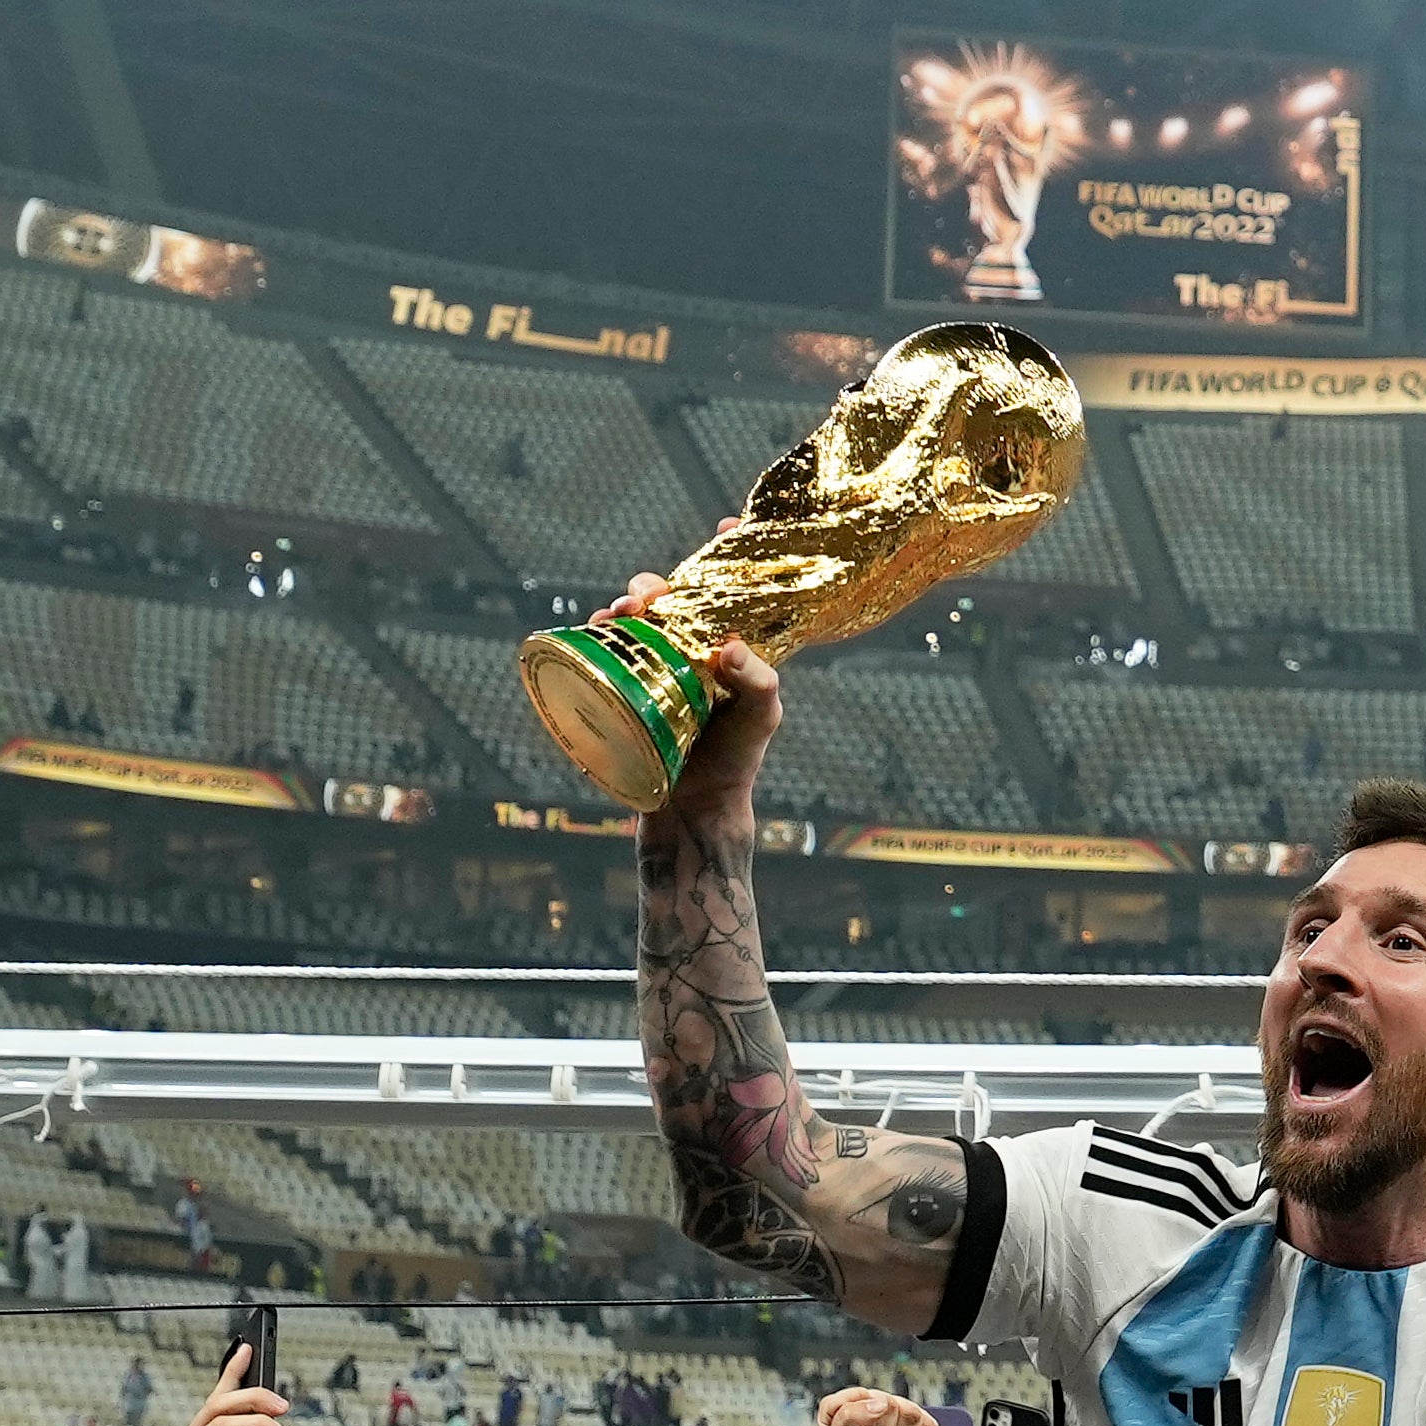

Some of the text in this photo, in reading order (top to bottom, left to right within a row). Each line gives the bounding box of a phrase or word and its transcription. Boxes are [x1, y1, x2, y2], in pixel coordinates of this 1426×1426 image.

[1078, 178, 1292, 217] FIFA WORLD CUP
[1174, 272, 1246, 307] The
[389, 284, 671, 365] The Final
[1126, 369, 1193, 394] FIFA
[1196, 369, 1305, 394] WORLD
[1310, 372, 1366, 397] CUP
